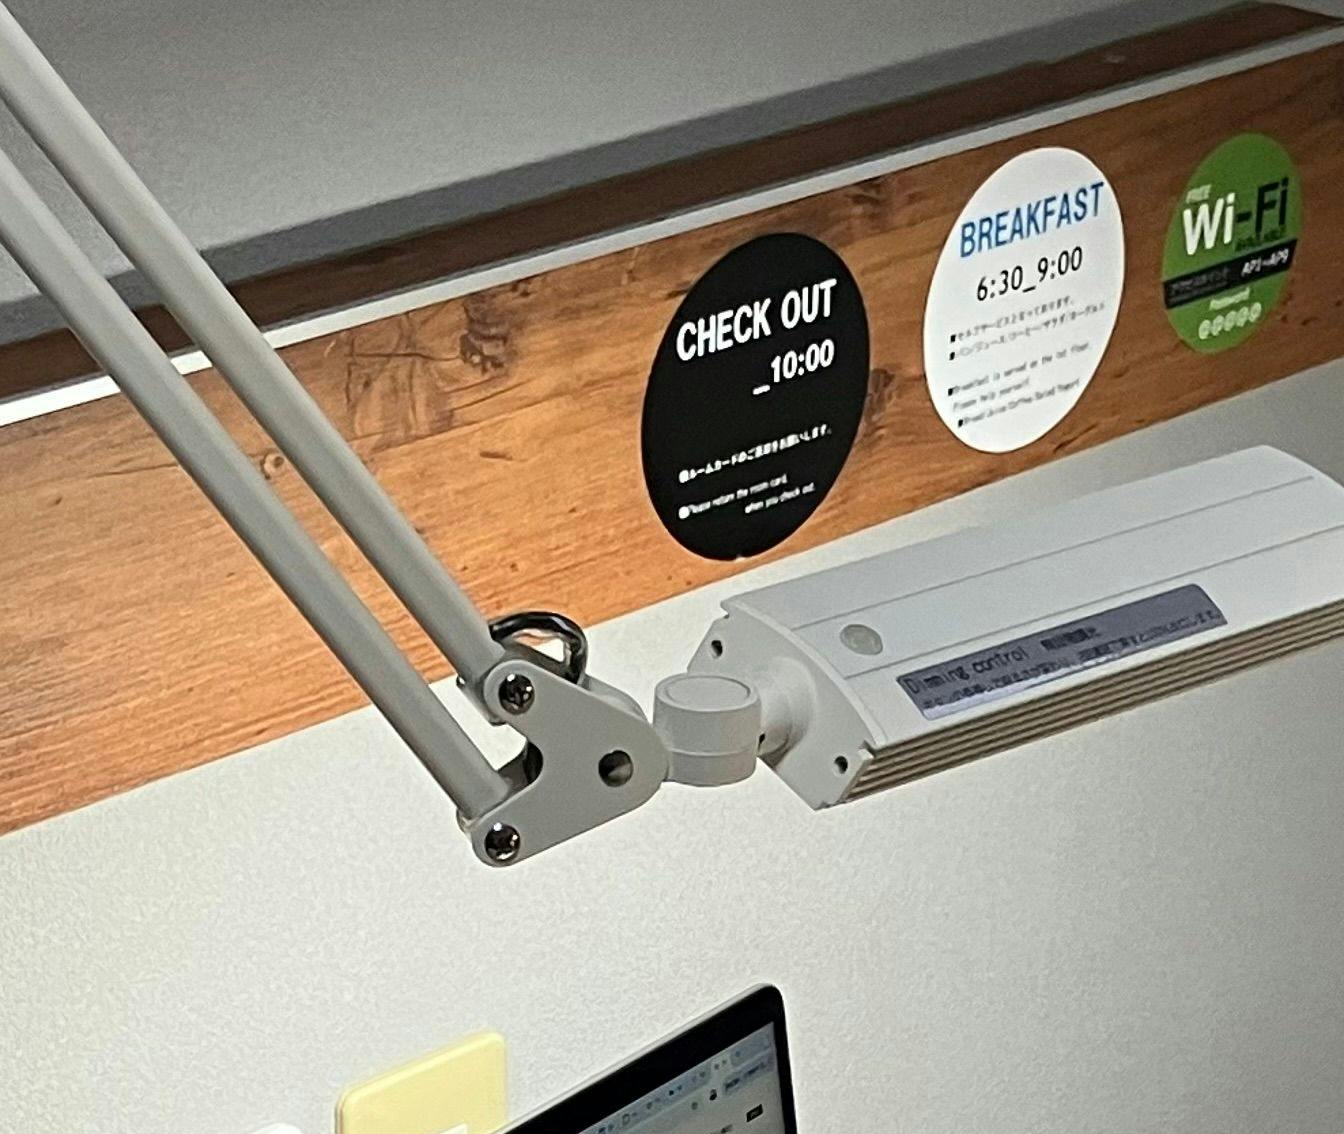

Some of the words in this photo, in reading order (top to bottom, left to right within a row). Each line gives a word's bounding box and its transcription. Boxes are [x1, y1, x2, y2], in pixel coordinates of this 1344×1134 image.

[959, 181, 1104, 259] BREAKFAST
[1183, 176, 1289, 256] Wi-Fi
[676, 298, 772, 361] CHECK
[781, 278, 838, 329] OUT
